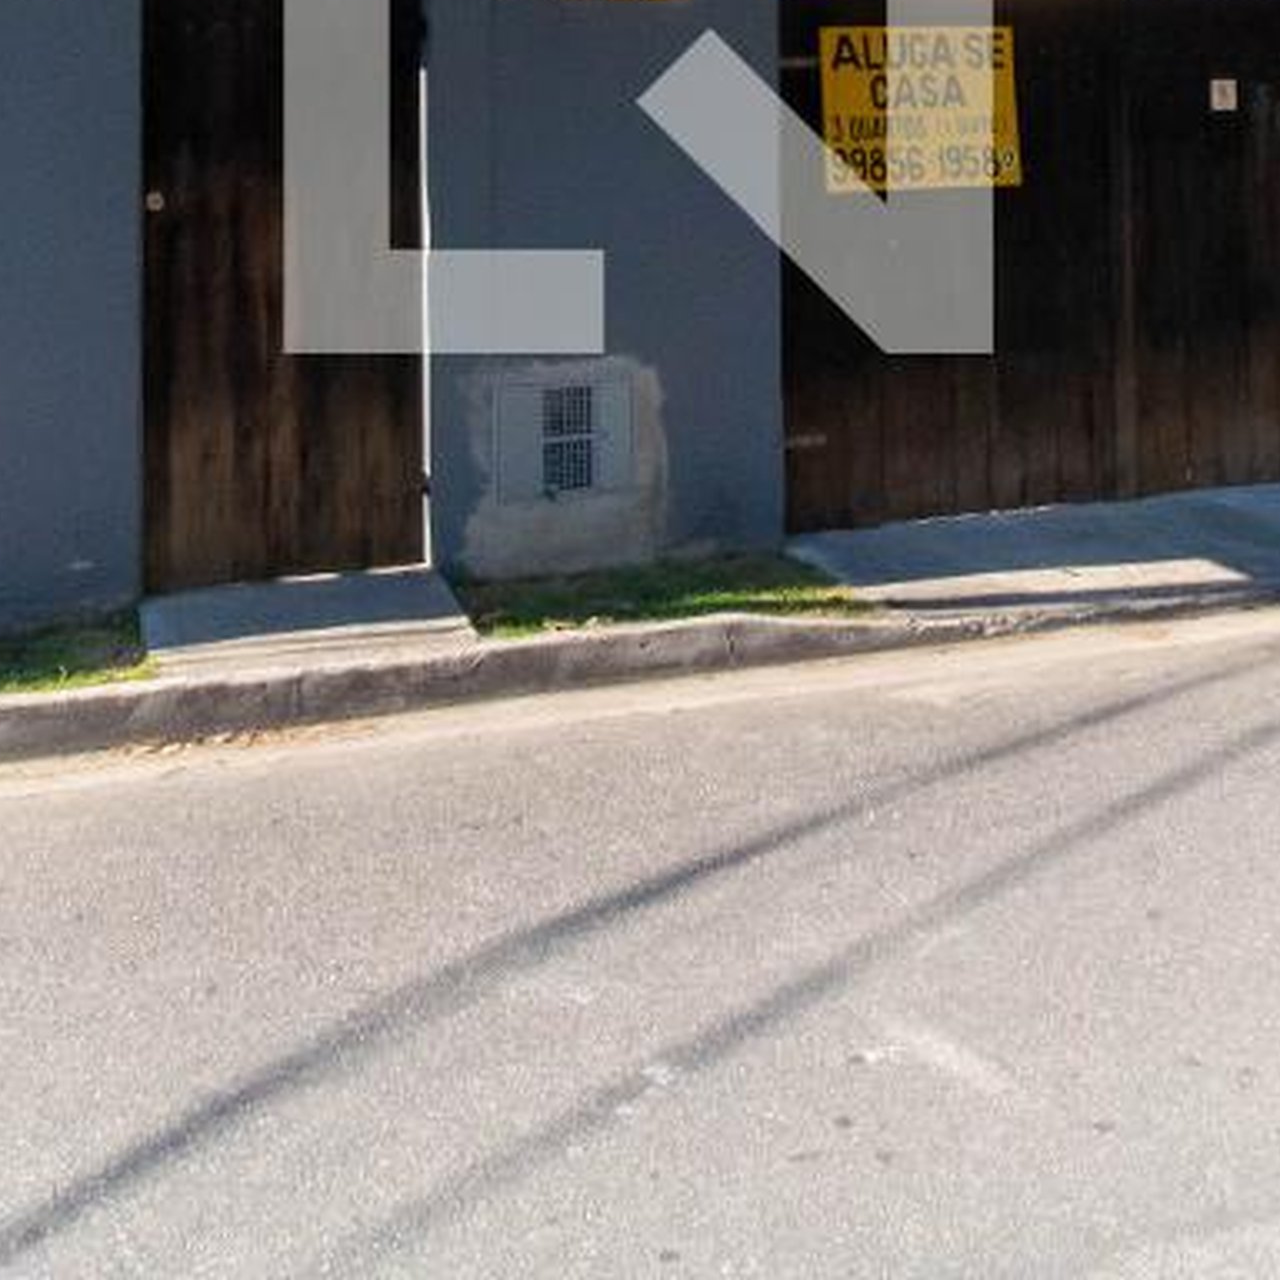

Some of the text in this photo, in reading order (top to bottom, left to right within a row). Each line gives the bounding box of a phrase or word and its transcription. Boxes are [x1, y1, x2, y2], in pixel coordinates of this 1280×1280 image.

[832, 32, 1005, 70] ALUGA SE
[869, 74, 967, 109] CASA
